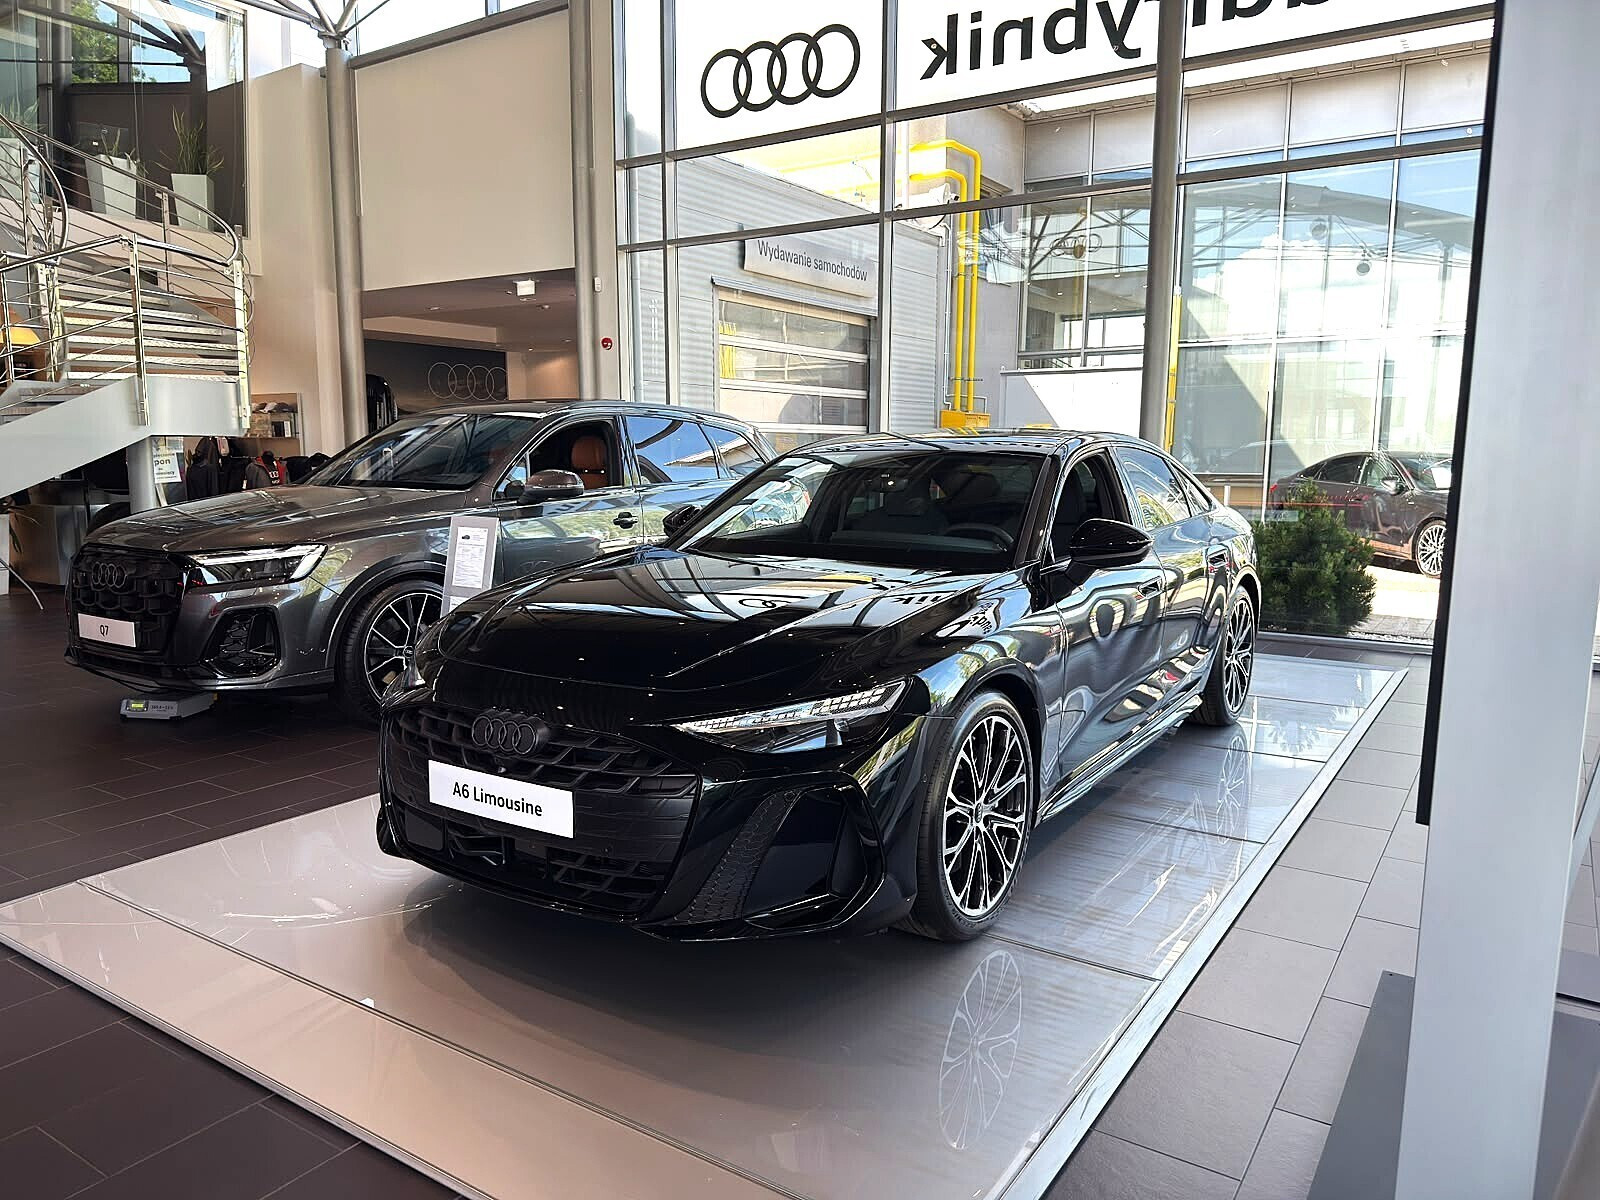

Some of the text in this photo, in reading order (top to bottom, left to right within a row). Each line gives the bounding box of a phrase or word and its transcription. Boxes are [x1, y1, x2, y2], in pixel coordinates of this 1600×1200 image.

[757, 239, 867, 281] Wydawanie samochodów
[99, 624, 109, 636] Q7
[453, 781, 543, 817] A6 Limousine
